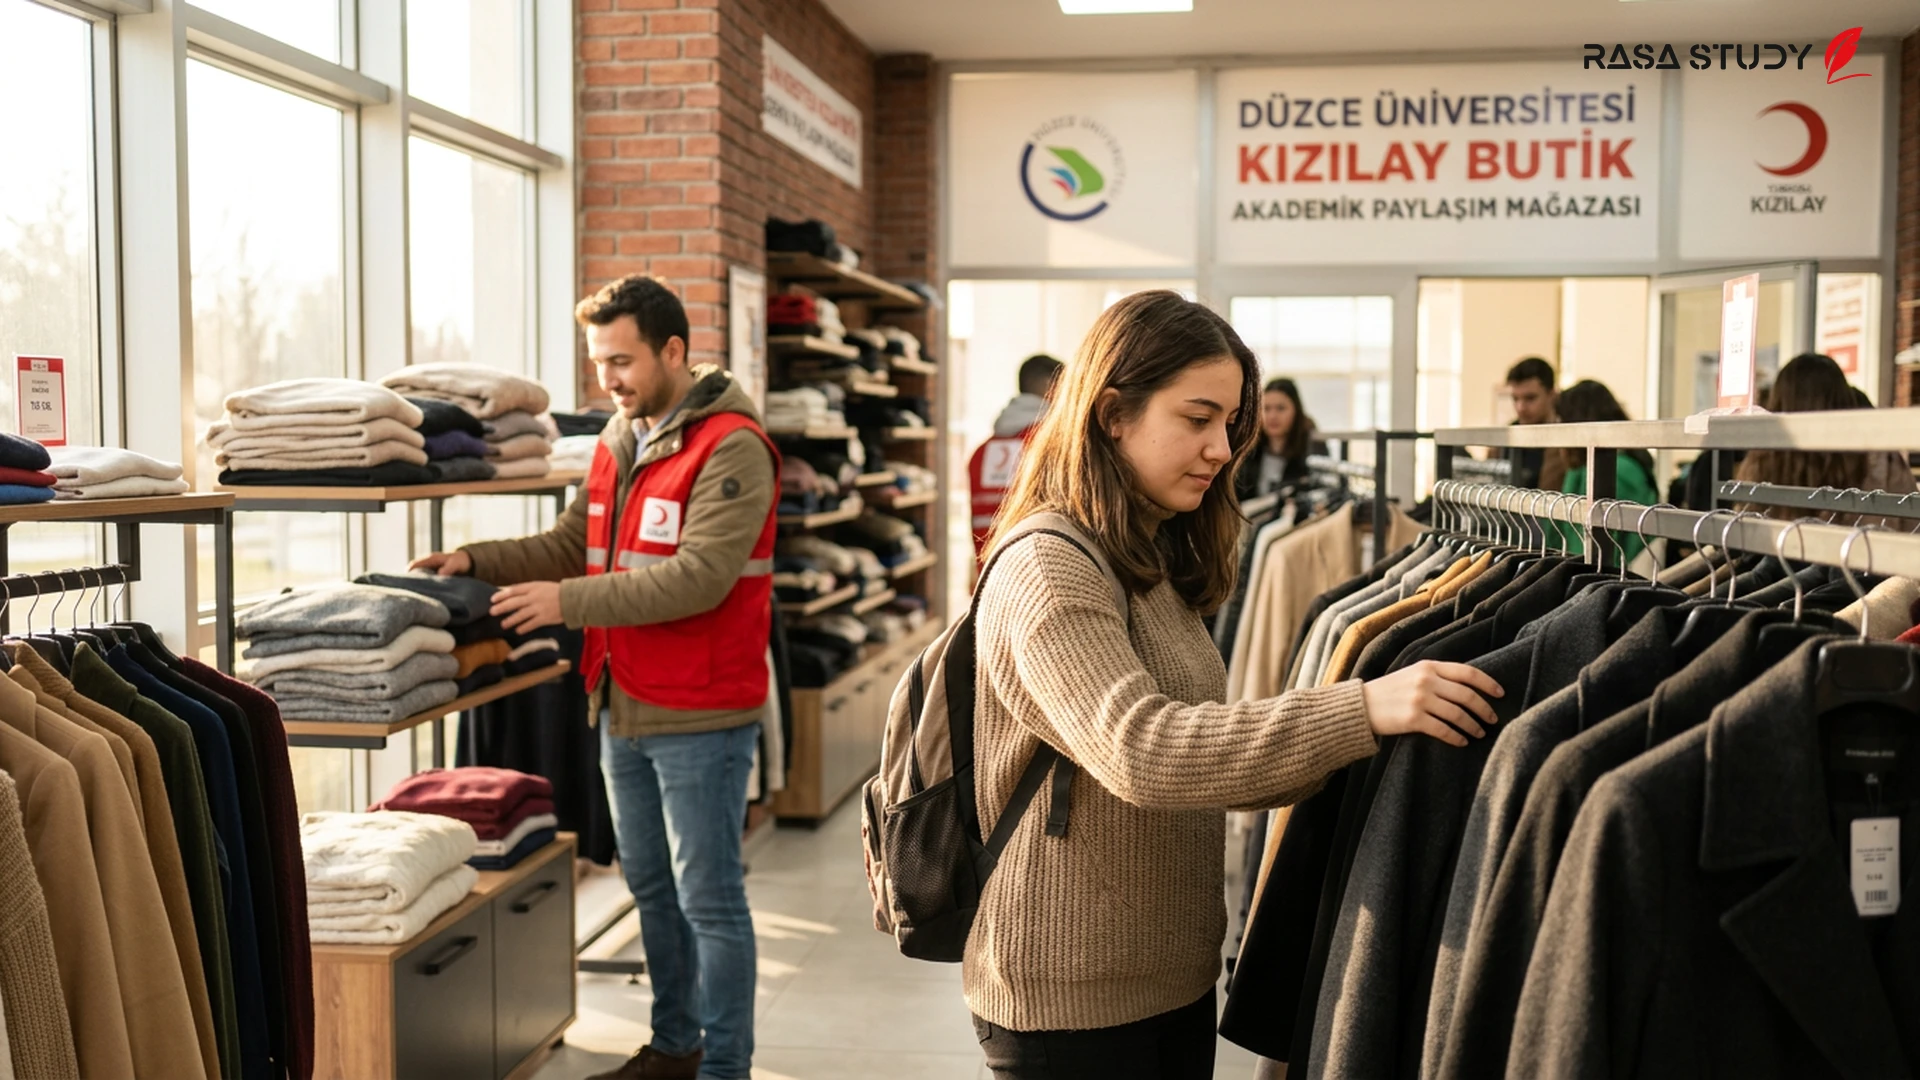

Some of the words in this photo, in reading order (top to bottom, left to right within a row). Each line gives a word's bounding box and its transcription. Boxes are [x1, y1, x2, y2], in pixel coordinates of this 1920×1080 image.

[1240, 92, 1363, 128] DÜZCE
[1375, 84, 1636, 127] ÜNİVERSİTESİ
[1238, 140, 1449, 184] KIZILAY
[1466, 128, 1636, 181] BUTİK
[1232, 195, 1365, 221] AKADEMİK
[1372, 196, 1498, 222] PAYLAŞIM
[1505, 192, 1642, 219] MAĞAZASI
[1750, 195, 1828, 213] KIZILAY
